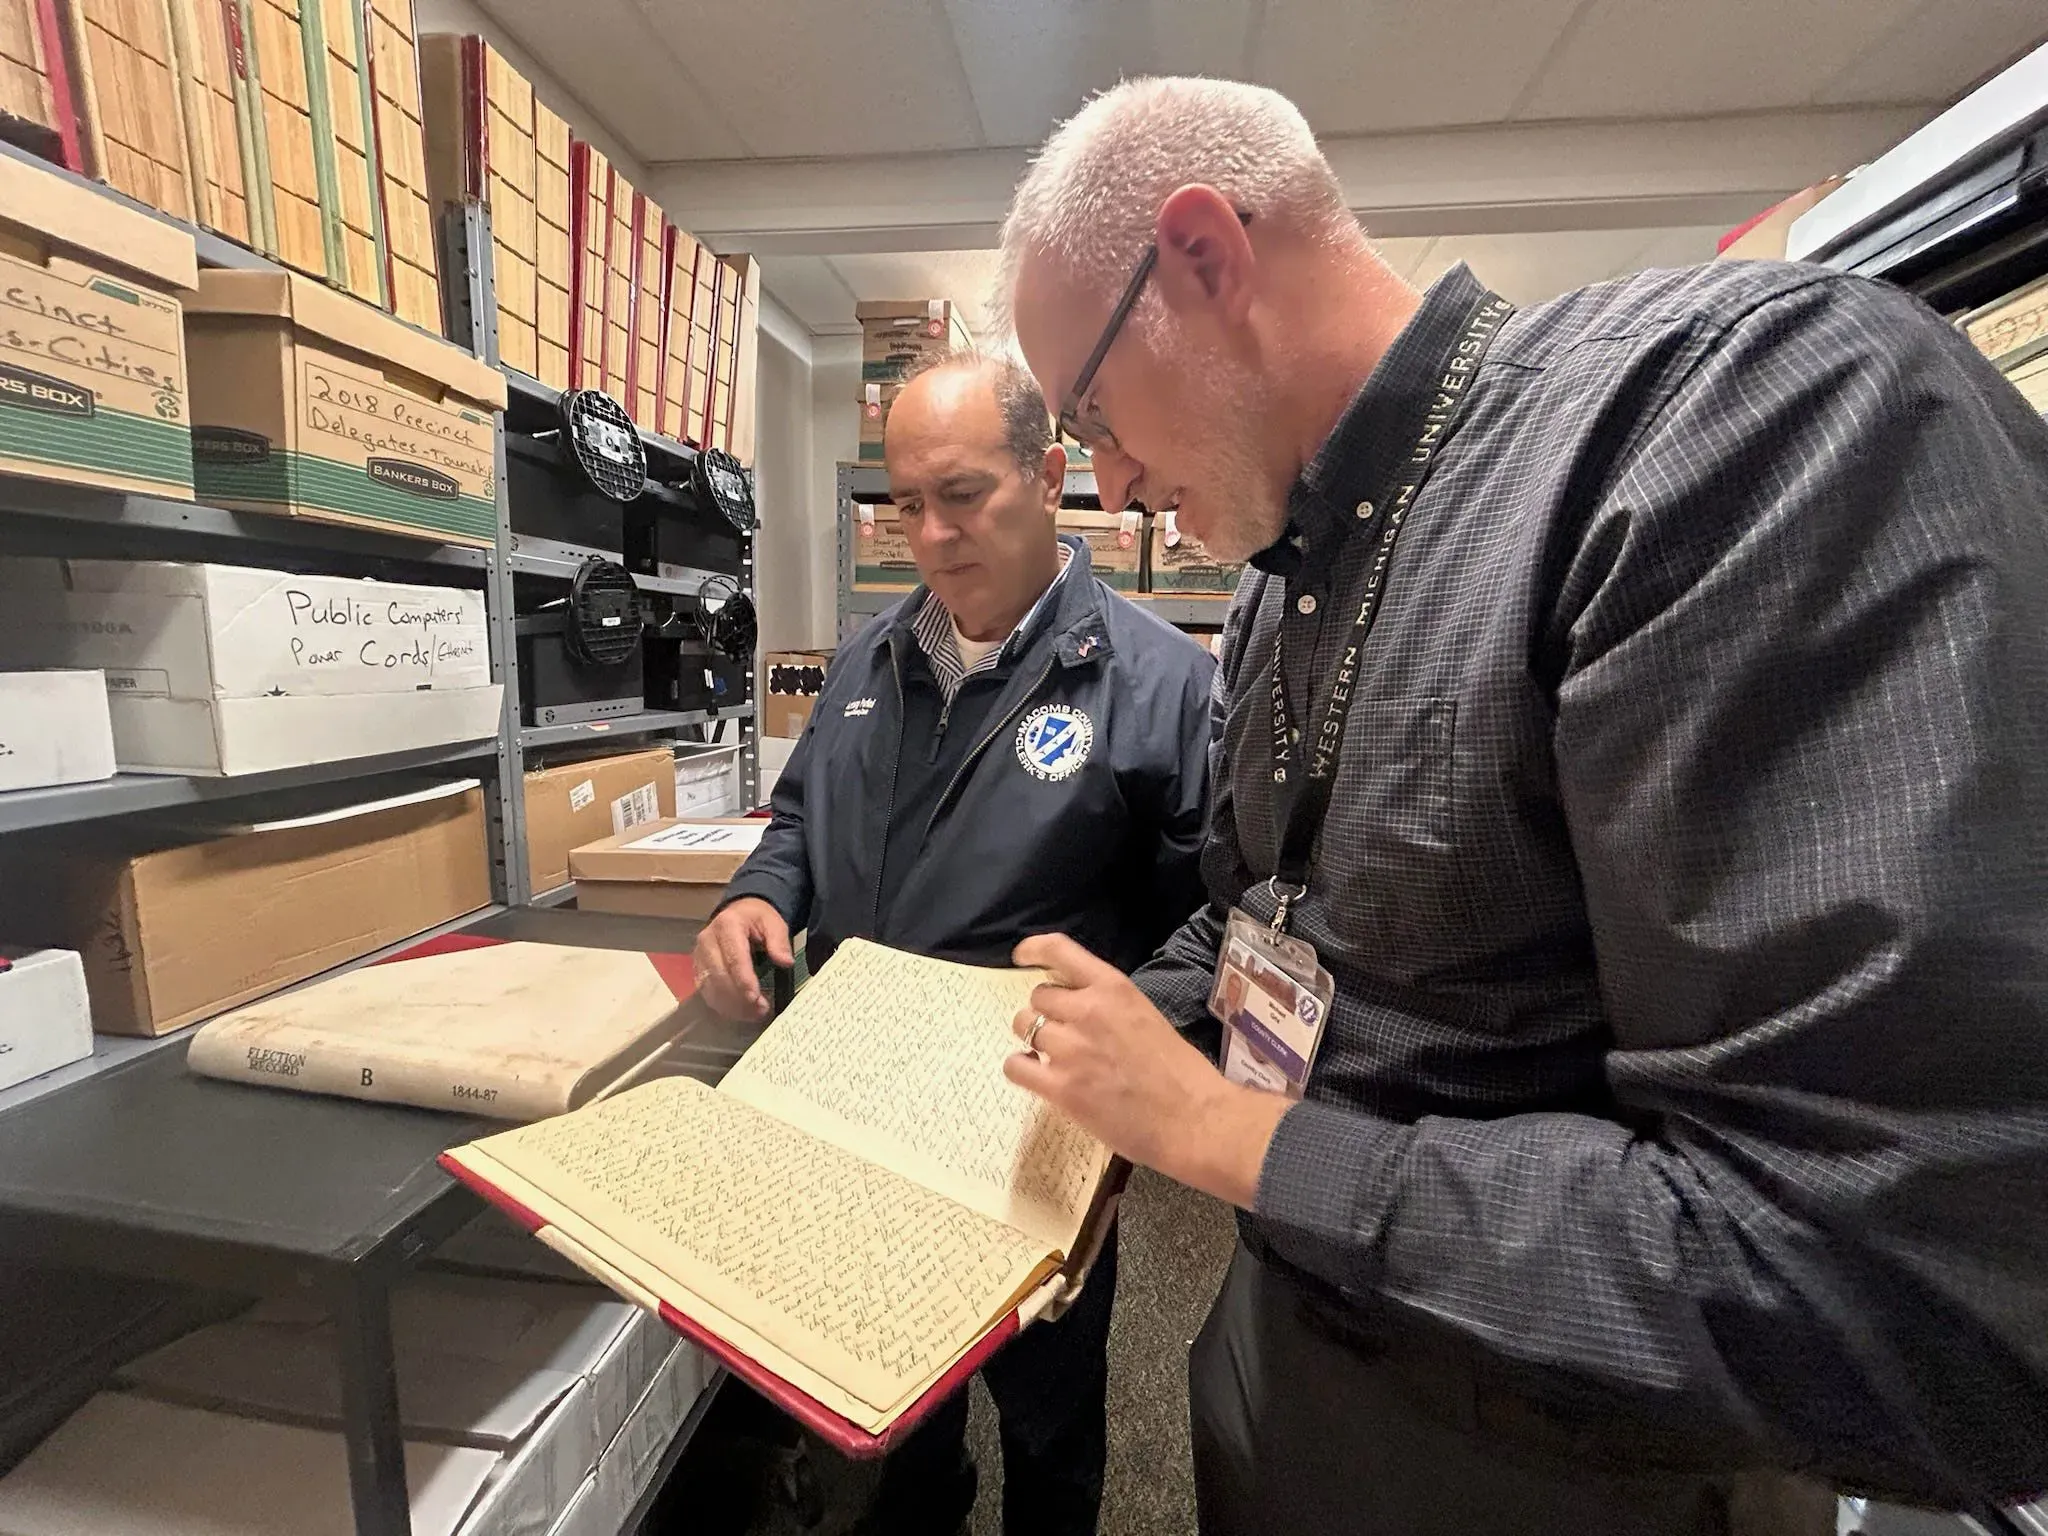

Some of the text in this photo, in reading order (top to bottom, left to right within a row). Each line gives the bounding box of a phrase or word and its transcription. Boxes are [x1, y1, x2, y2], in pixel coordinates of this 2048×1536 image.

[31, 383, 85, 408] BOX
[315, 375, 475, 446] 2018 Precinct
[373, 464, 454, 494] BANKERS BOX
[1309, 304, 1502, 778] WESTERN MICHIGAN UNIVERSITY
[286, 590, 373, 626] Public
[1017, 704, 1094, 753] MACOMB COUNTY
[1015, 736, 1088, 782] CLERK'S OFFICE
[247, 1046, 307, 1067] ELECTION
[249, 1059, 300, 1077] RECORD
[360, 1067, 373, 1087] B
[452, 1084, 499, 1102] 1844-87
